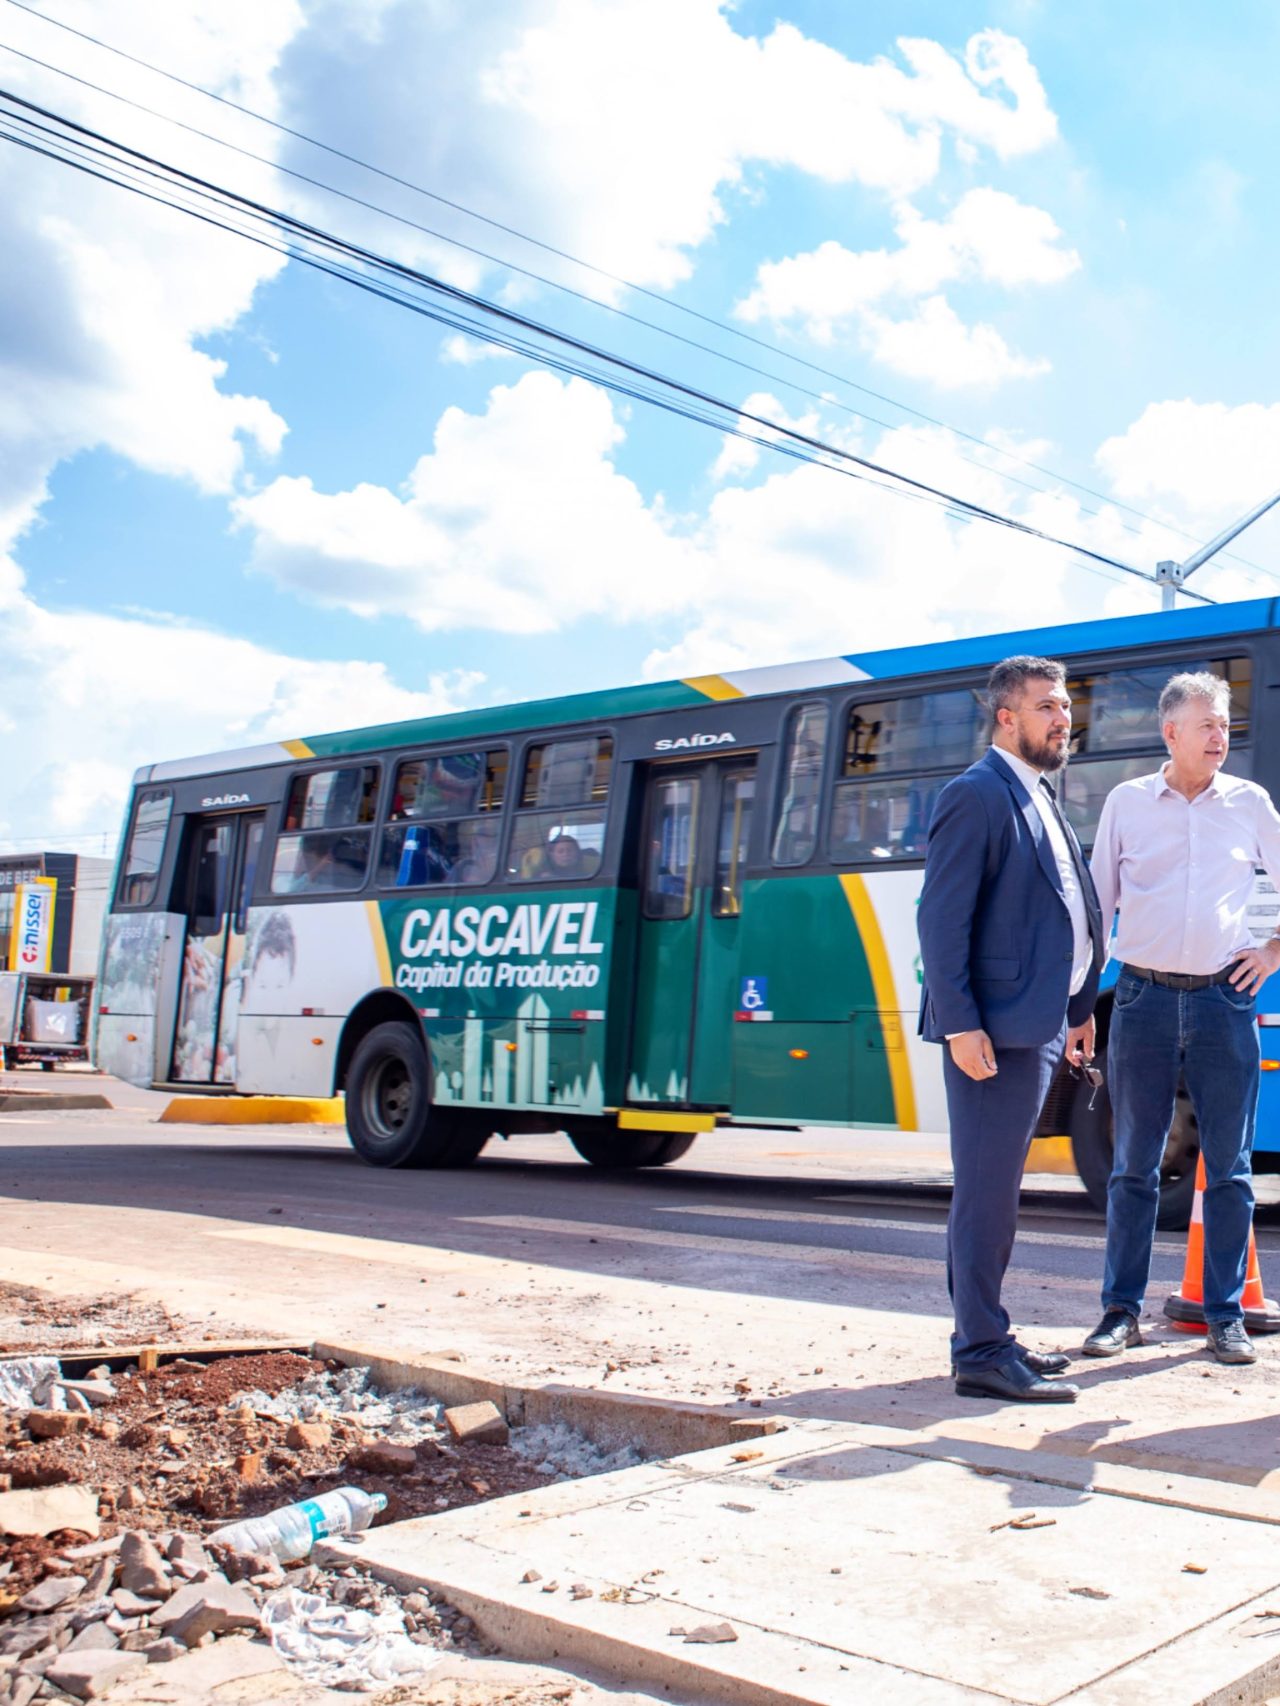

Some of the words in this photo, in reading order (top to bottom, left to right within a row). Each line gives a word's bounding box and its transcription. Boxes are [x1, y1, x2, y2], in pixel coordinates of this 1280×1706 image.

[654, 732, 737, 750] SAÍDA
[201, 794, 250, 807] SAÍDA
[400, 902, 605, 958] CASCAVEL
[395, 960, 464, 993] Capital
[464, 960, 494, 988] da
[494, 960, 600, 991] Produção
